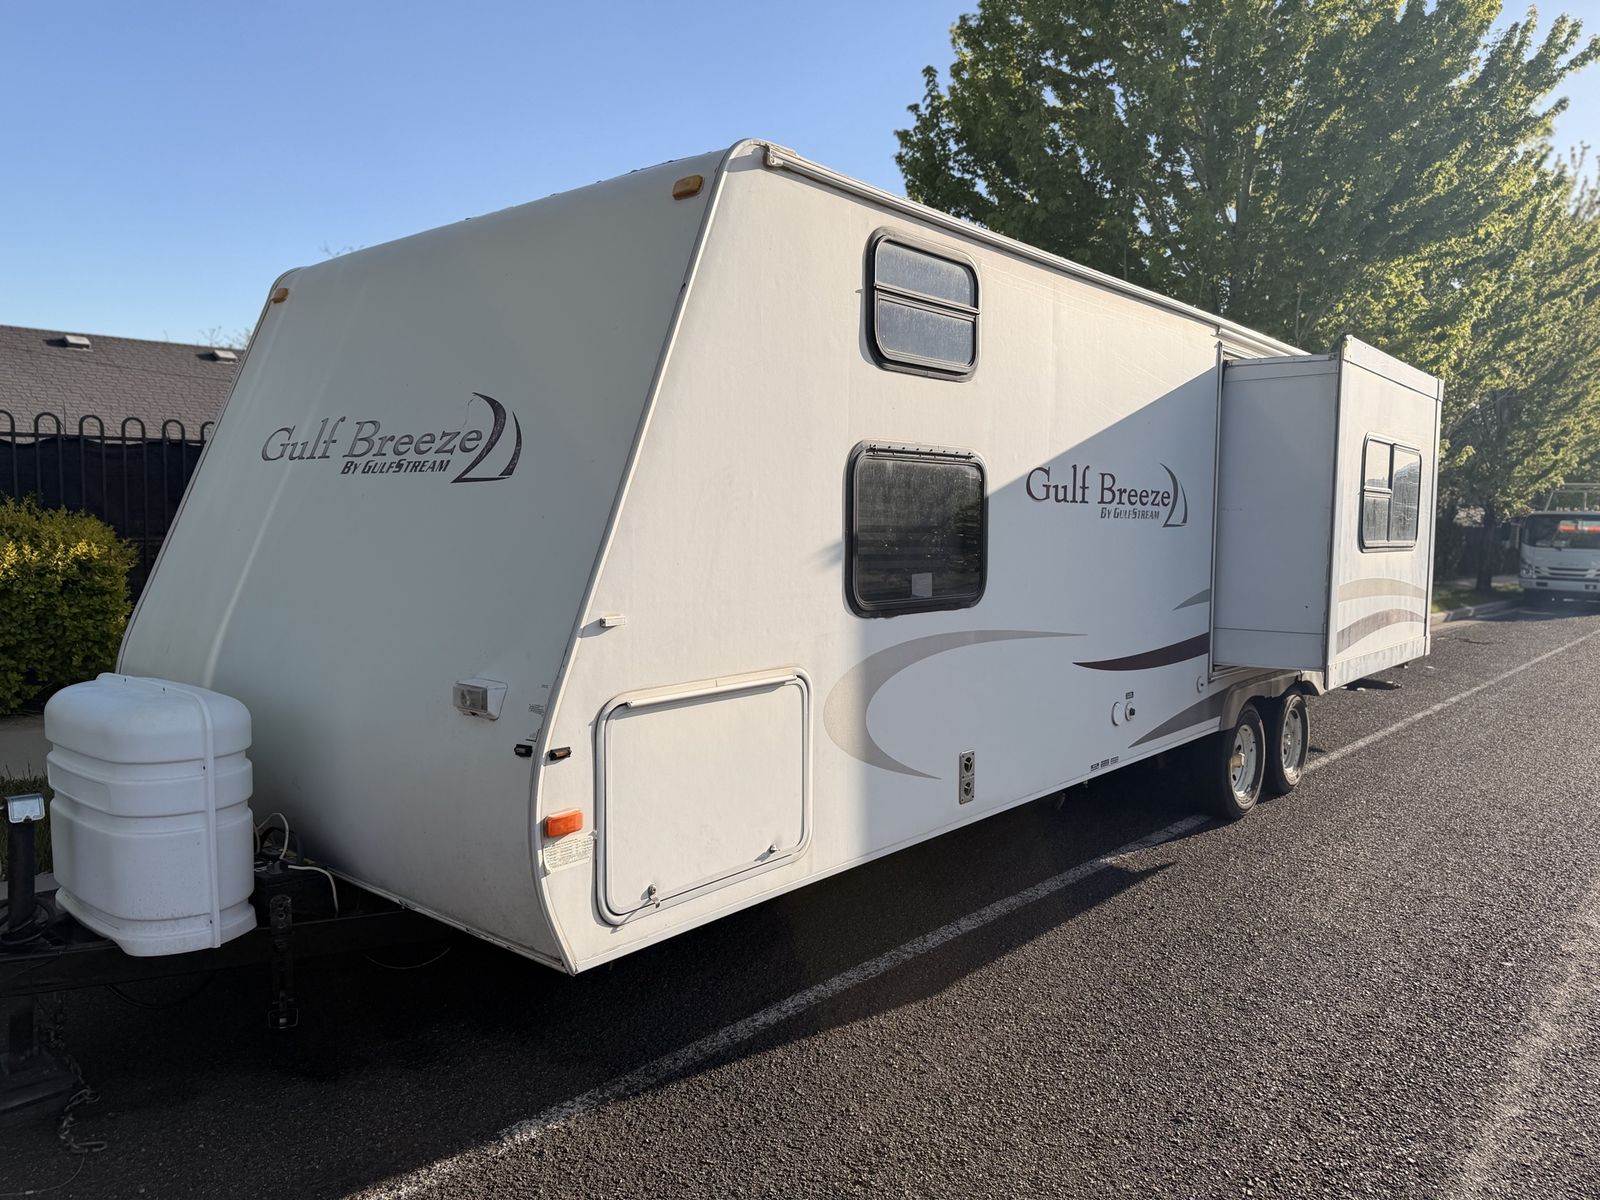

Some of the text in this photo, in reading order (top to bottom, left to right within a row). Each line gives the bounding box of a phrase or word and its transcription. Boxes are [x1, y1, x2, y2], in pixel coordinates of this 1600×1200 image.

[261, 416, 483, 462] Gulf Breeze
[1026, 464, 1171, 507] Gulf Breeze
